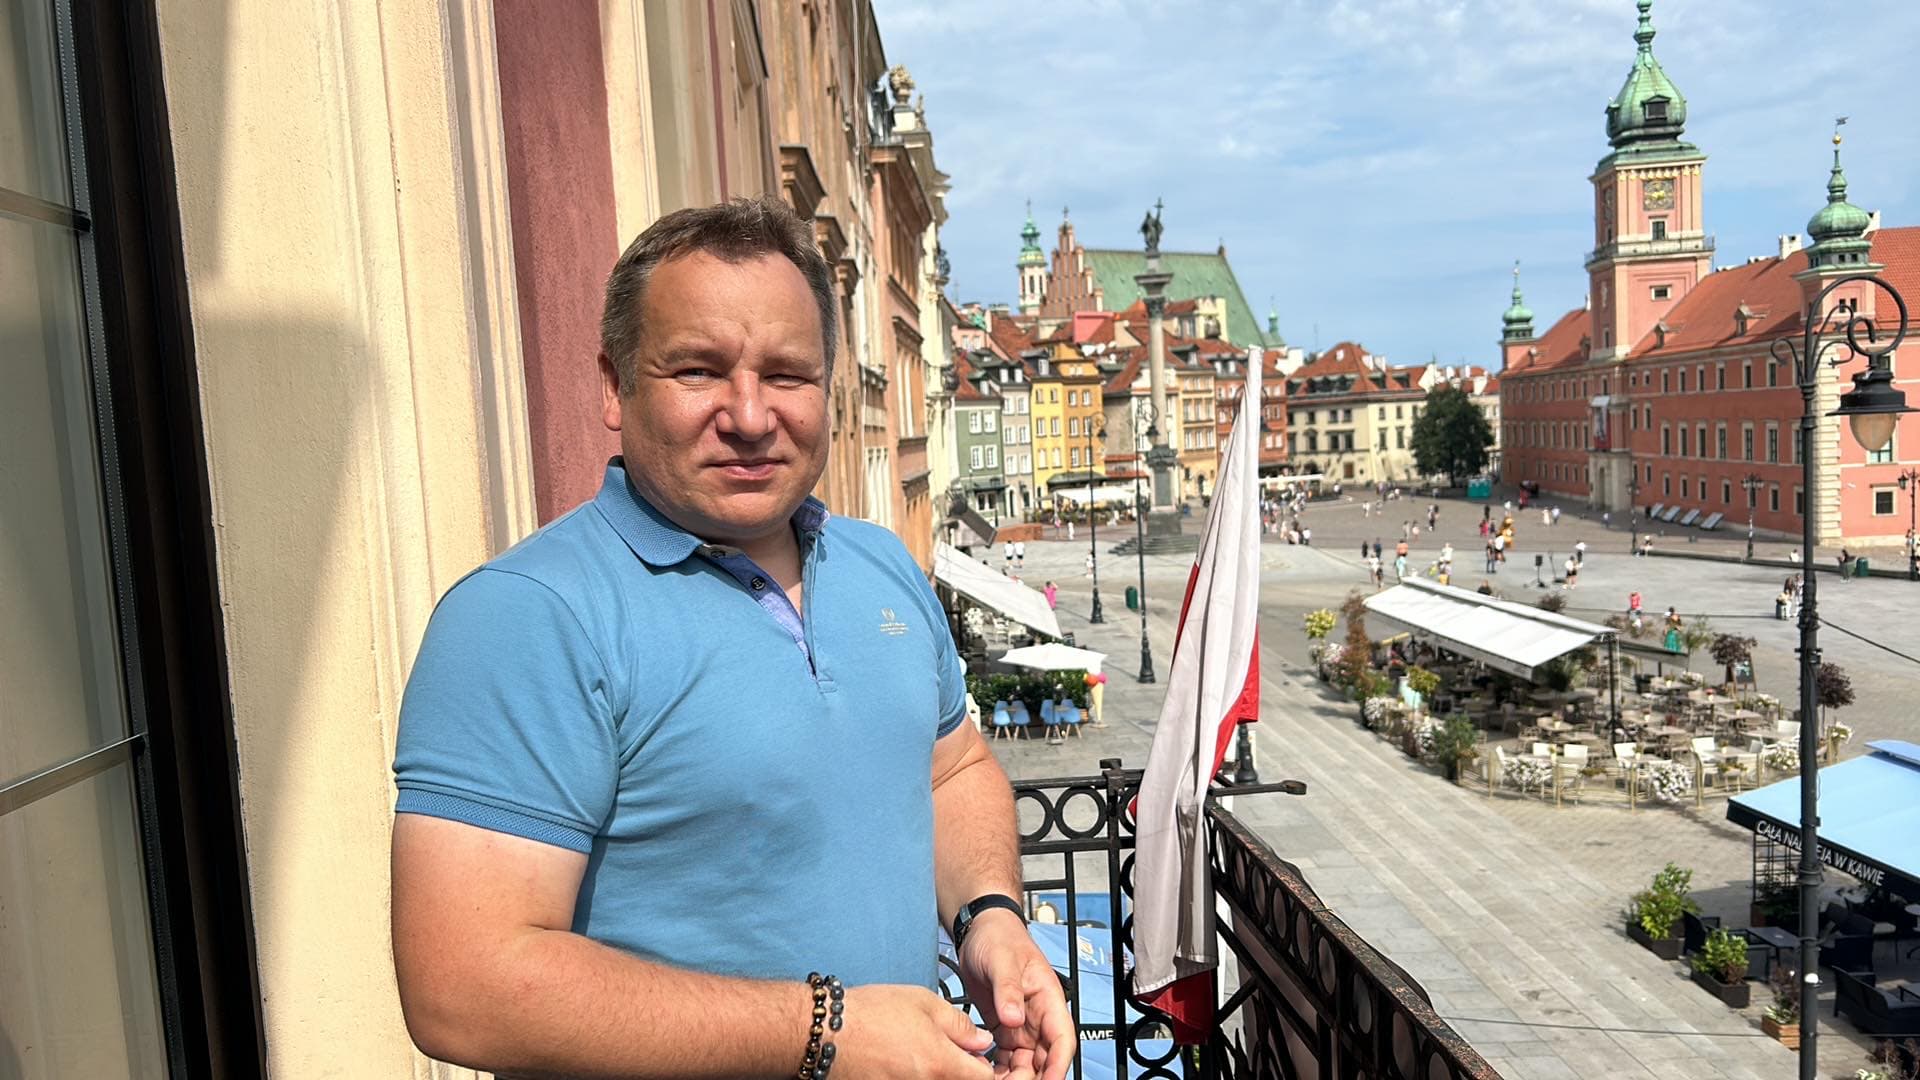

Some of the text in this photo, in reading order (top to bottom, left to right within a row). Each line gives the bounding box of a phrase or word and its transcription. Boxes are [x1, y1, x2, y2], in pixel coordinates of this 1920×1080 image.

[1757, 820, 1782, 842] CAŁA
[1835, 852, 1848, 868] W
[1847, 859, 1885, 886] KAWIE
[1080, 1030, 1114, 1040] AWIE
